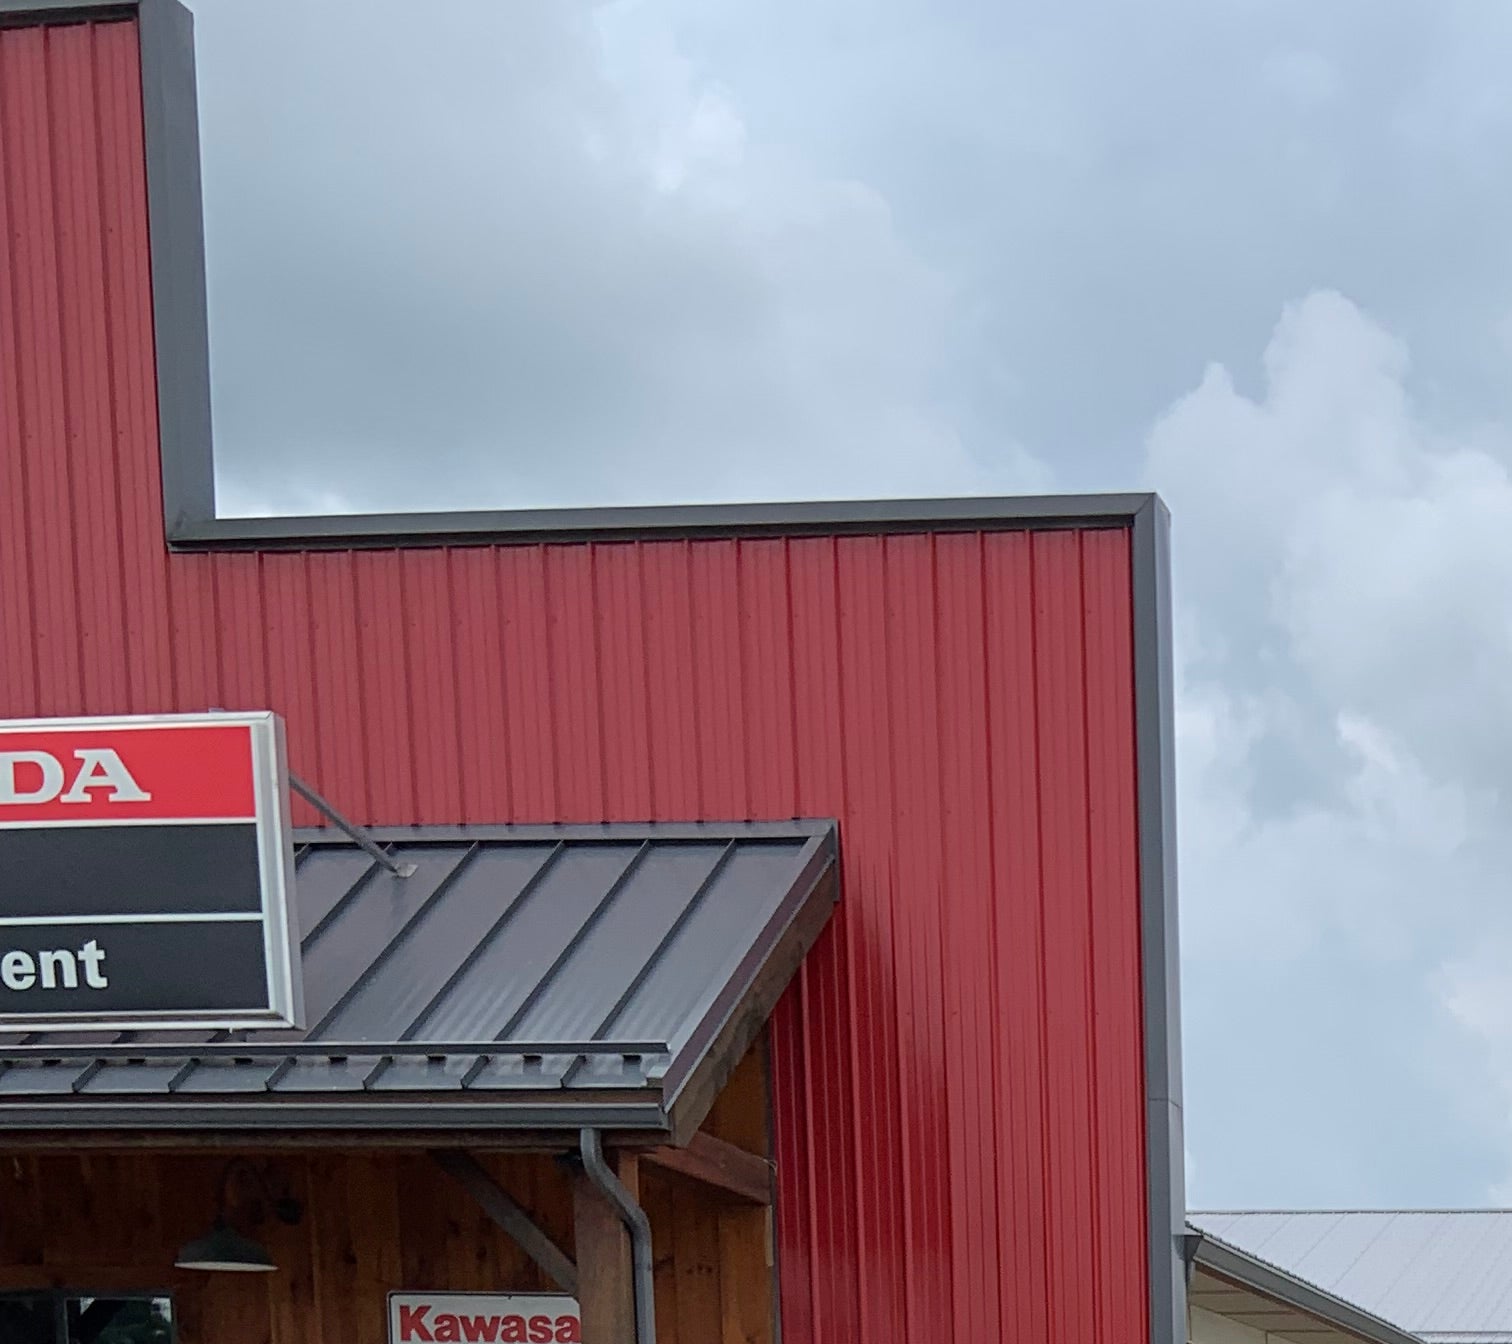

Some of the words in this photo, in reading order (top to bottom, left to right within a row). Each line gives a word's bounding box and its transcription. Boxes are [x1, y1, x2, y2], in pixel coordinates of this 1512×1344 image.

[0, 748, 152, 804] DA
[1, 940, 108, 990] ent
[400, 1304, 582, 1344] Kawasa
